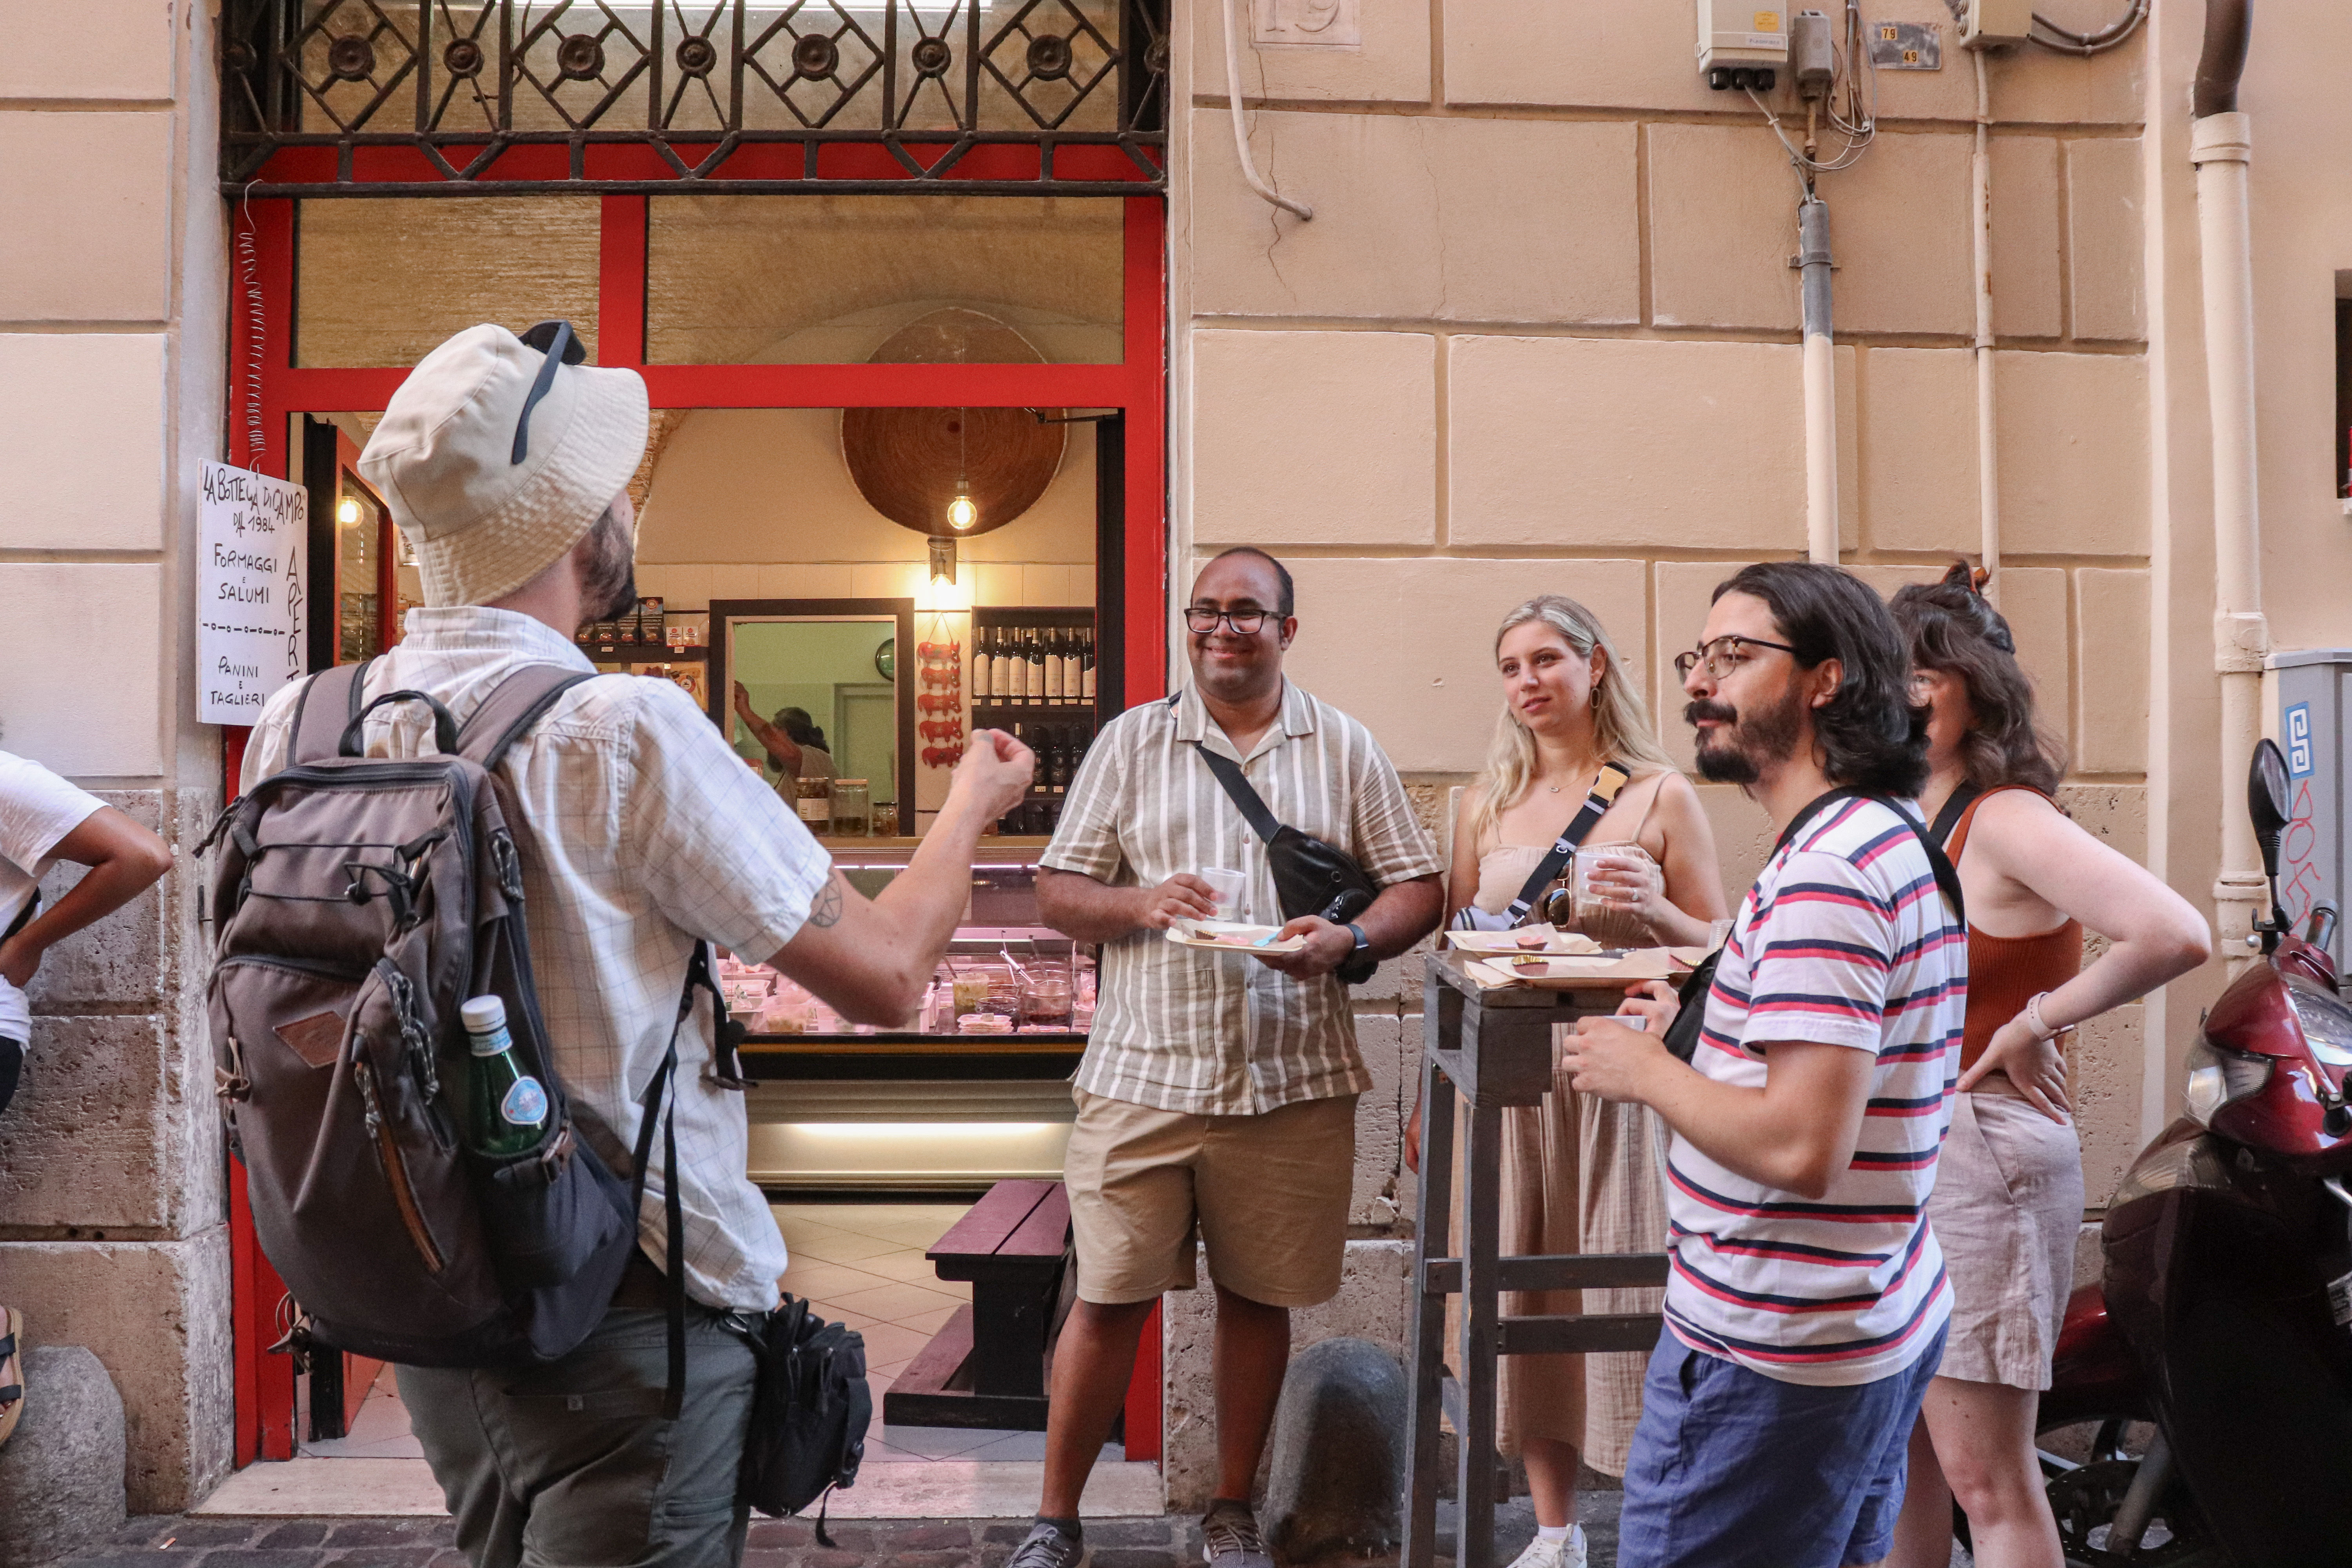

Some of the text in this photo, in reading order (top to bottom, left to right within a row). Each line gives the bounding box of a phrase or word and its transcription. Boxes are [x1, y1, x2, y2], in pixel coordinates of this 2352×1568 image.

[1883, 28, 1896, 39] 79
[1904, 52, 1917, 62] 49
[203, 465, 216, 505] LA
[234, 511, 275, 538] DAL 1984
[214, 543, 277, 573] FORMAGGI
[218, 583, 269, 604] SALUMI
[218, 656, 258, 678] PANINI
[239, 681, 243, 690] E
[211, 691, 265, 707] TAGLIERI
